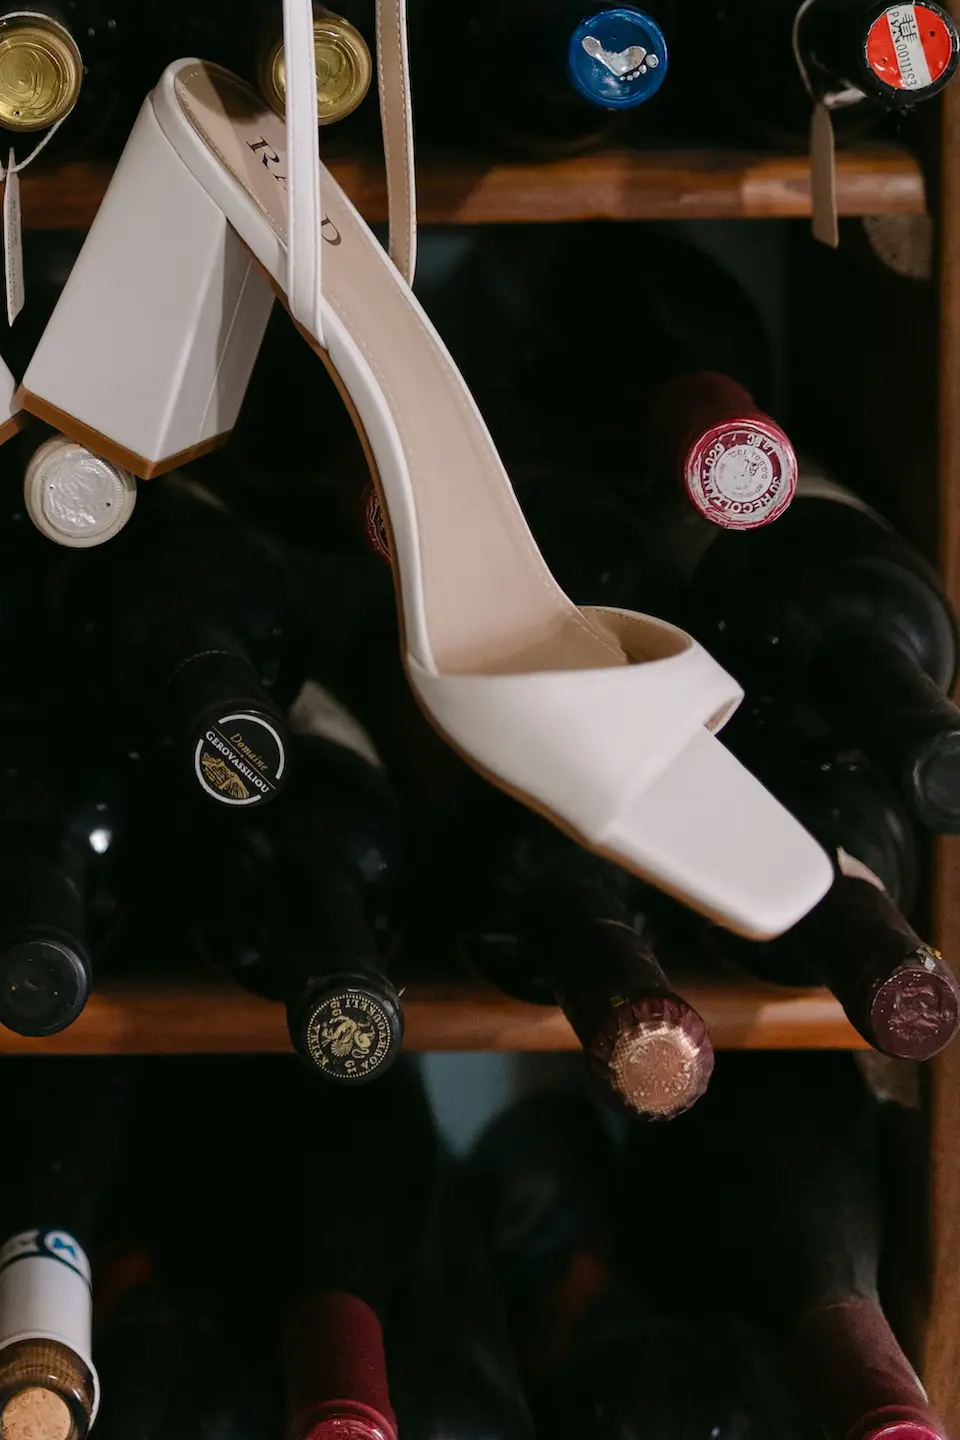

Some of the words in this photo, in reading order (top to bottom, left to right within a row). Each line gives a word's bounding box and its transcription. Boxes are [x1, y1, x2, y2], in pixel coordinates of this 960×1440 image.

[705, 442, 726, 468] 029
[205, 730, 270, 793] GEROVASSILIOU
[230, 732, 268, 771] Domaine
